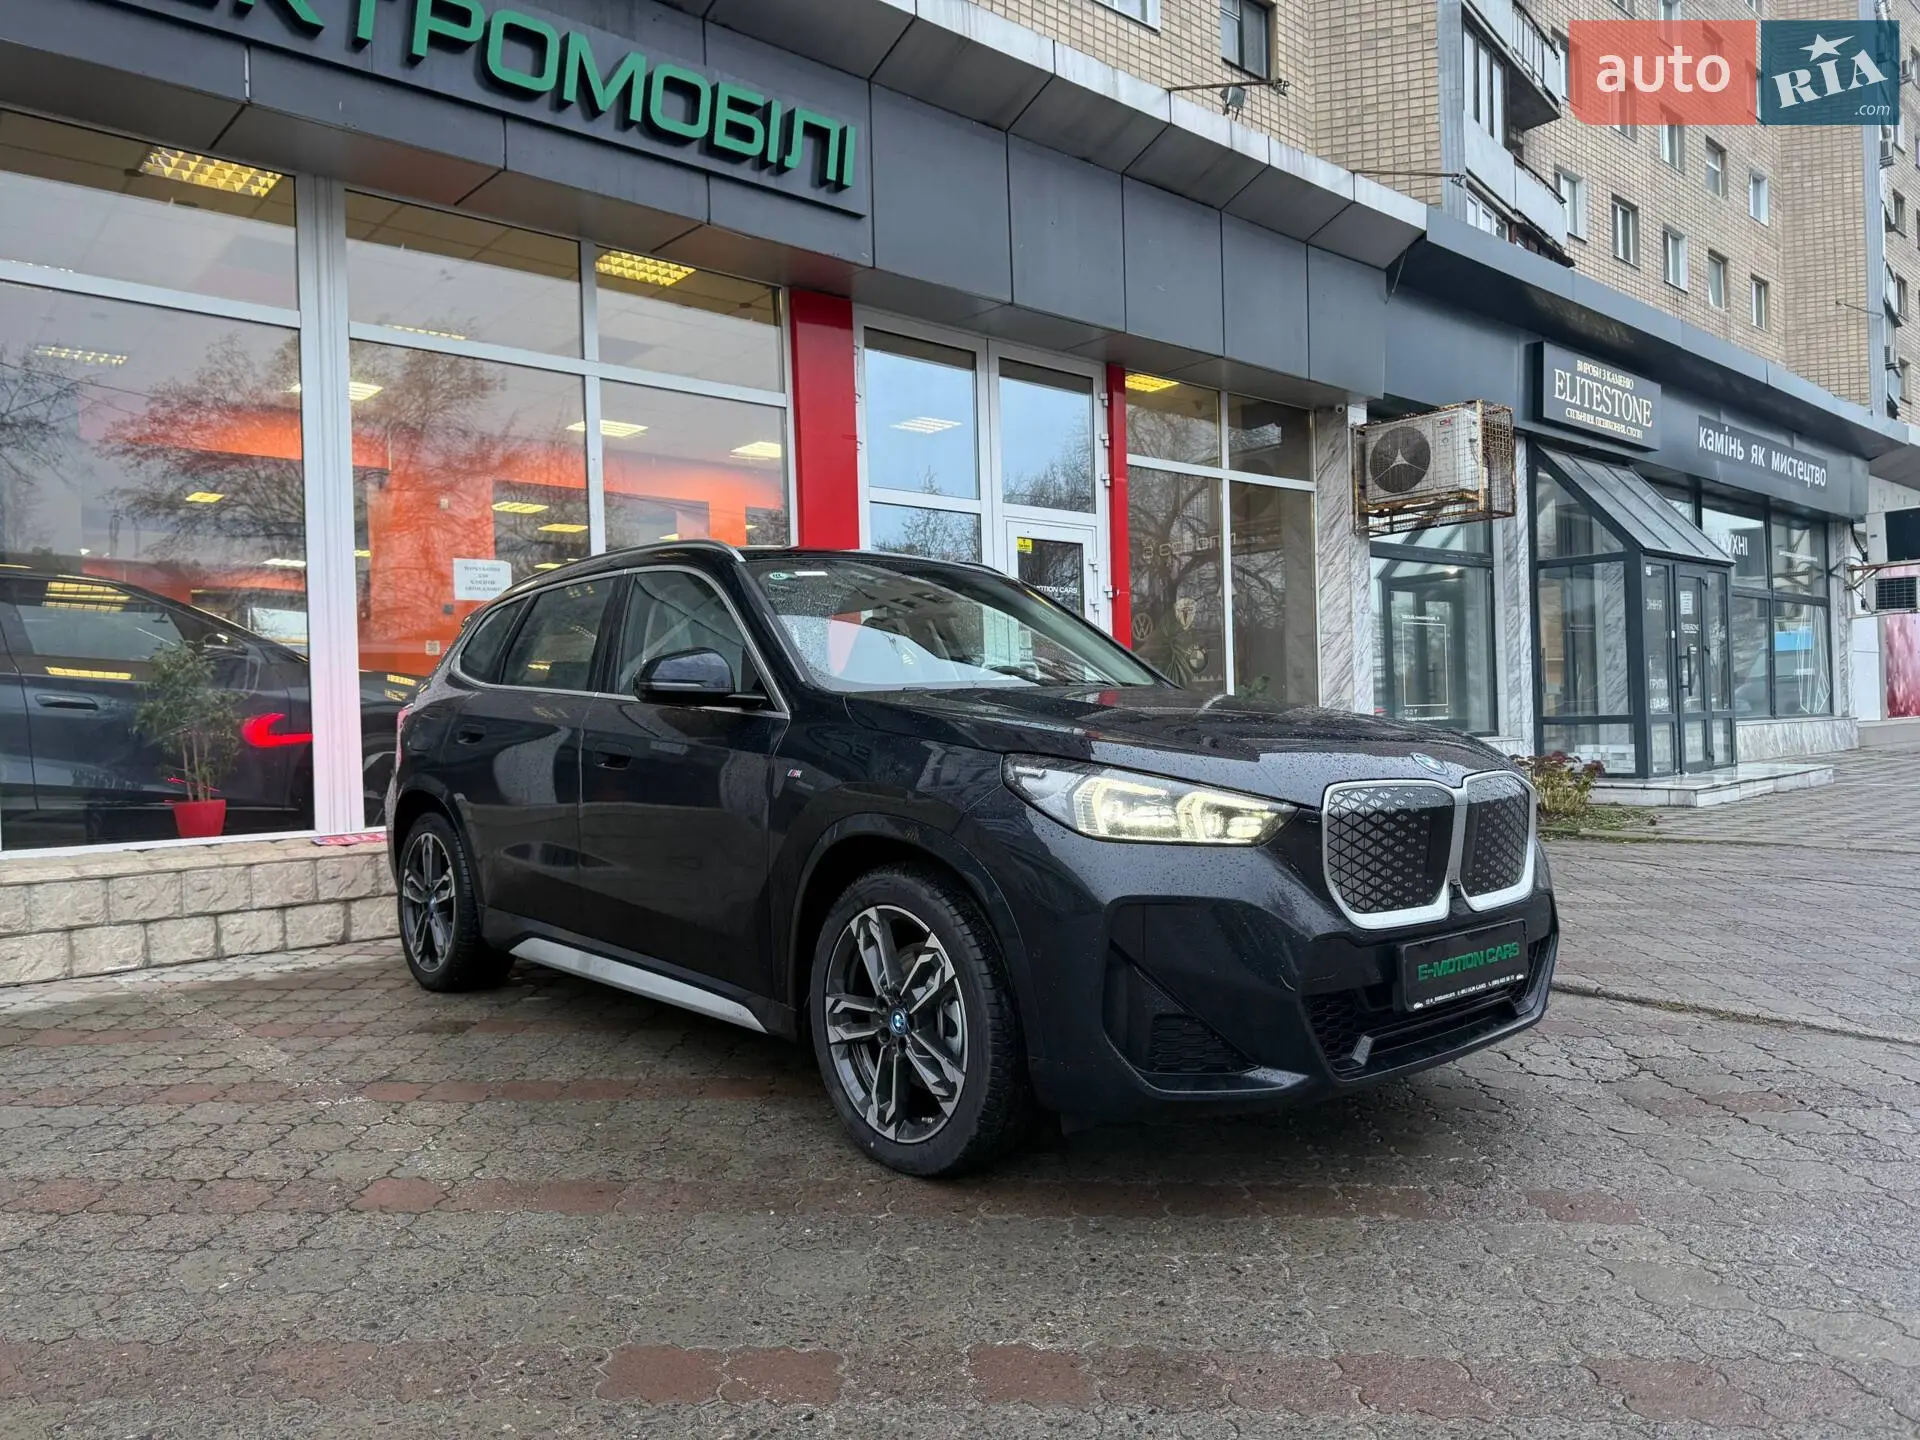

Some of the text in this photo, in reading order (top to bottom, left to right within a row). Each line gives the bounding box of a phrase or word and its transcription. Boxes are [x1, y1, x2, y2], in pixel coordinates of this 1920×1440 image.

[1554, 368, 1653, 428] ELITESTONE
[1699, 426, 1827, 488] камінь як мистецтво
[1417, 950, 1485, 981] E-MOTION
[1486, 942, 1520, 964] CARS
